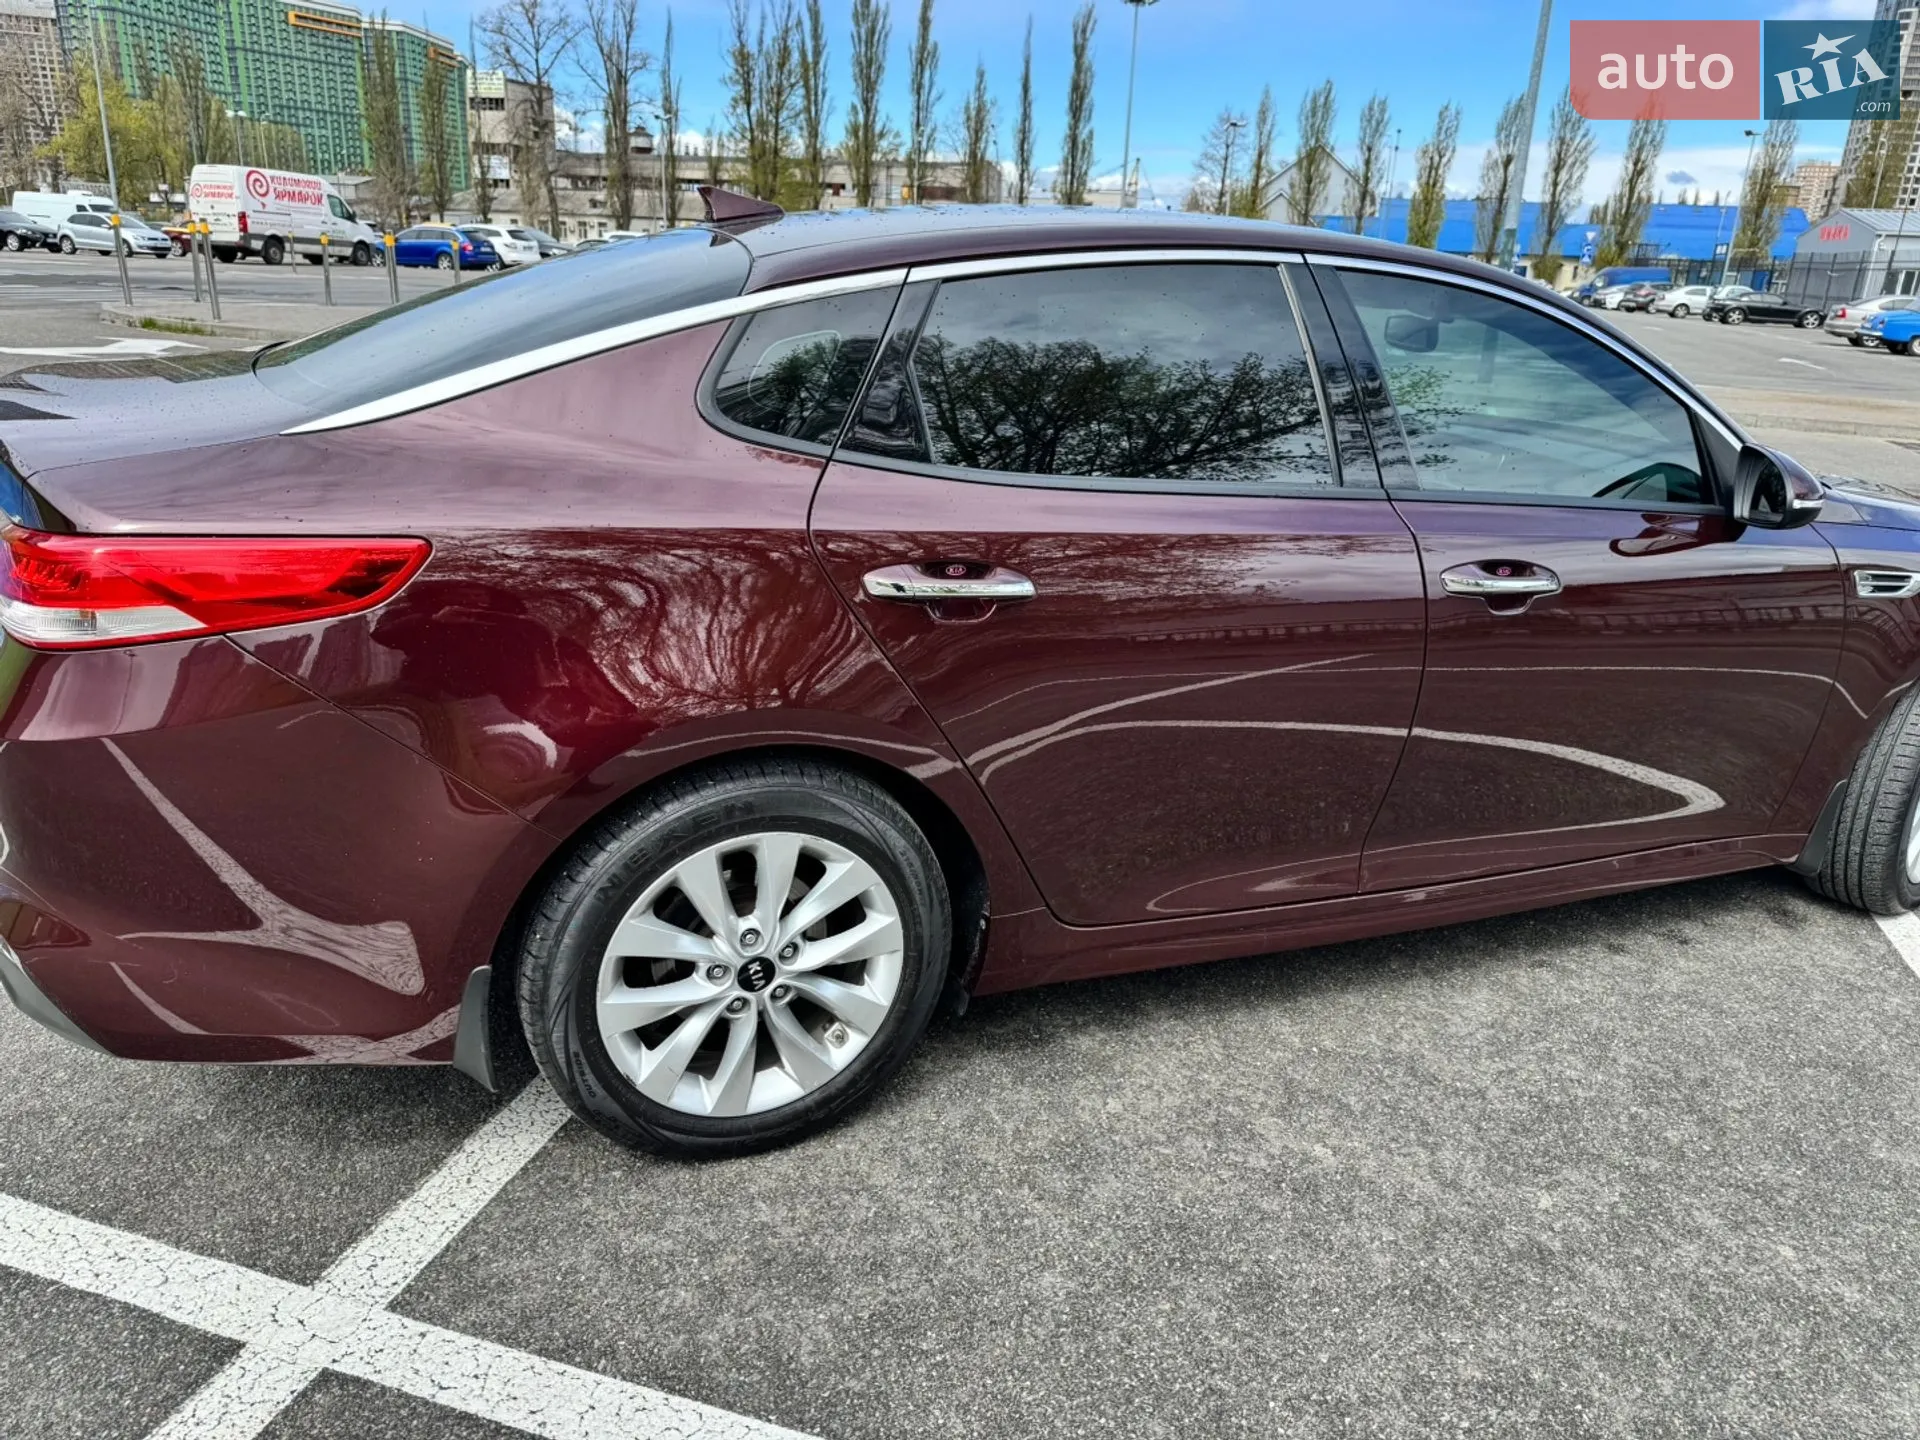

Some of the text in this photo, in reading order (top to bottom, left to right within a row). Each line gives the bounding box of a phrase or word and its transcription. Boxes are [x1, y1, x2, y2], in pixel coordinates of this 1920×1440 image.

[273, 187, 324, 206] ЯРМАРОК
[597, 799, 754, 904] NEXEN
[747, 961, 766, 991] KIA
[572, 1051, 598, 1099] OUTSIDE
